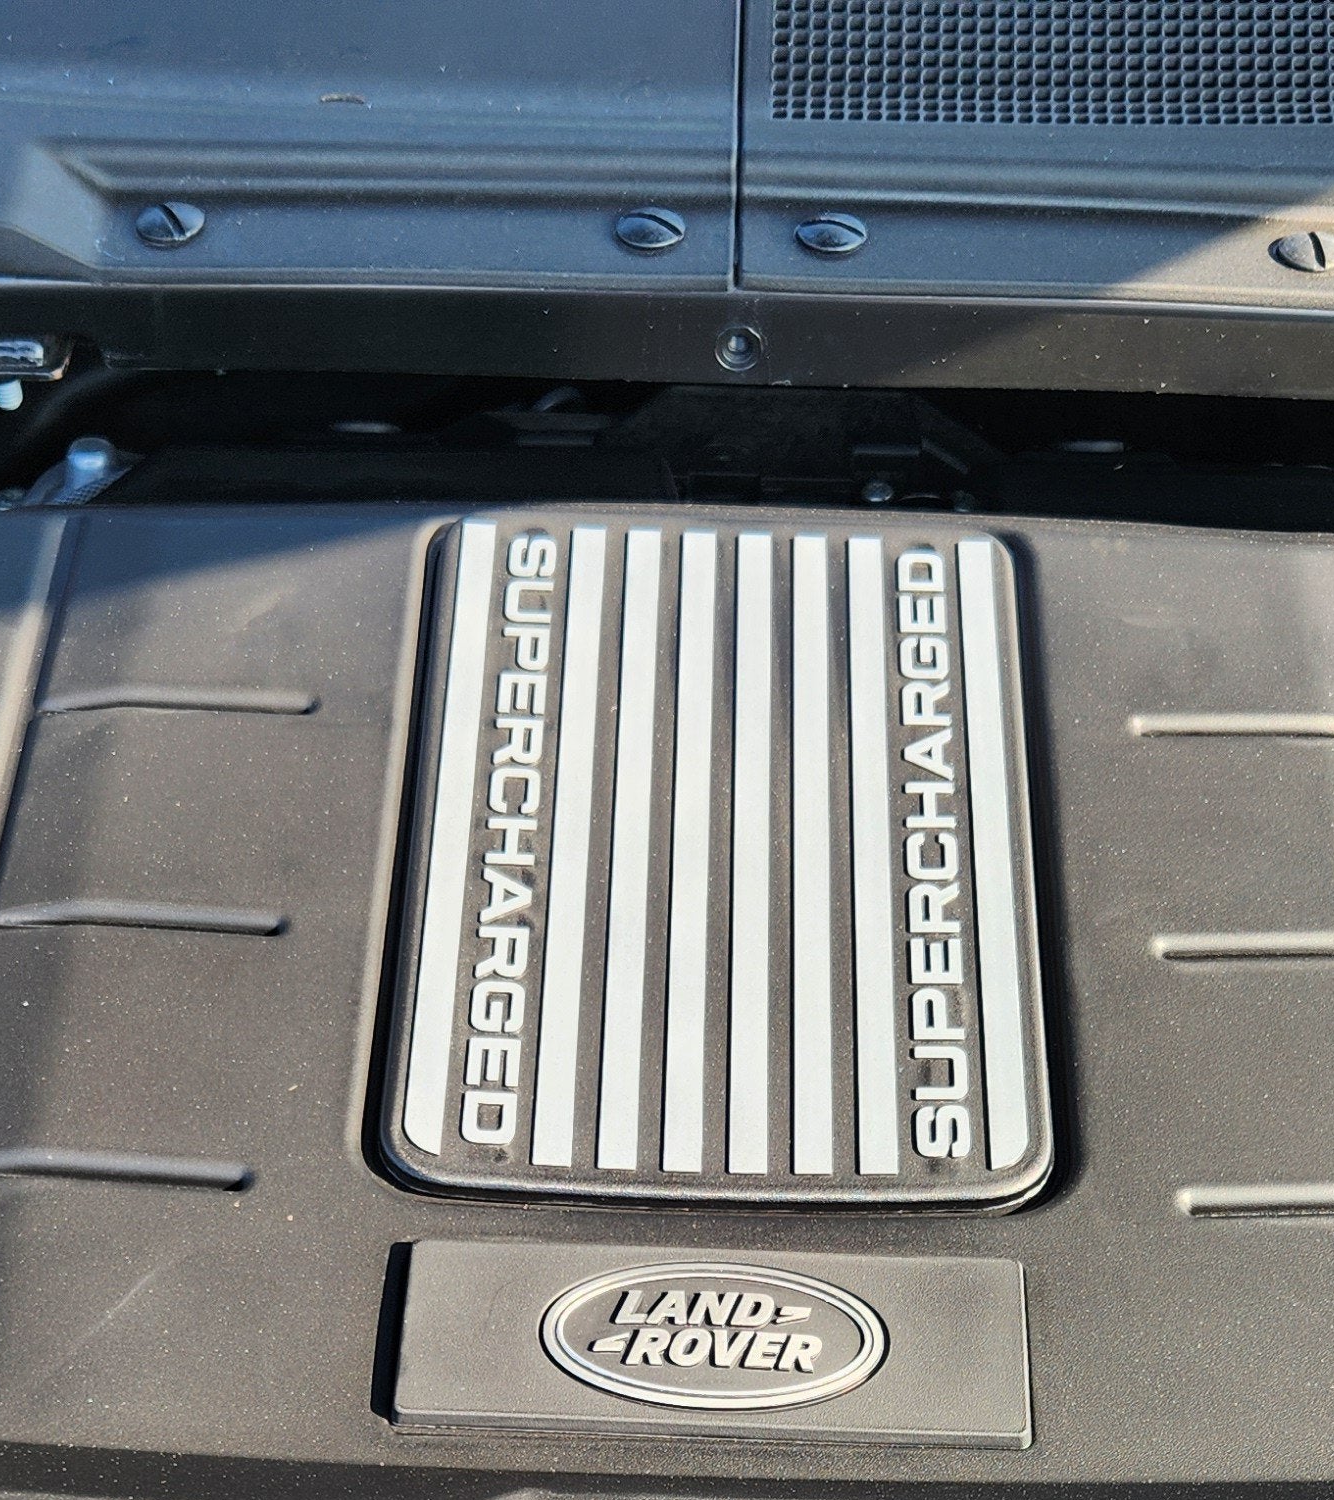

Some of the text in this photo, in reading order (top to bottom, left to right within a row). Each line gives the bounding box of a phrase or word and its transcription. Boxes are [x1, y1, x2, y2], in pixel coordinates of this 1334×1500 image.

[460, 531, 557, 1145] SUPERCHARGED
[897, 549, 971, 1159] SUPERCHARGED
[610, 1289, 775, 1329] LAND
[620, 1328, 823, 1374] ROVER
